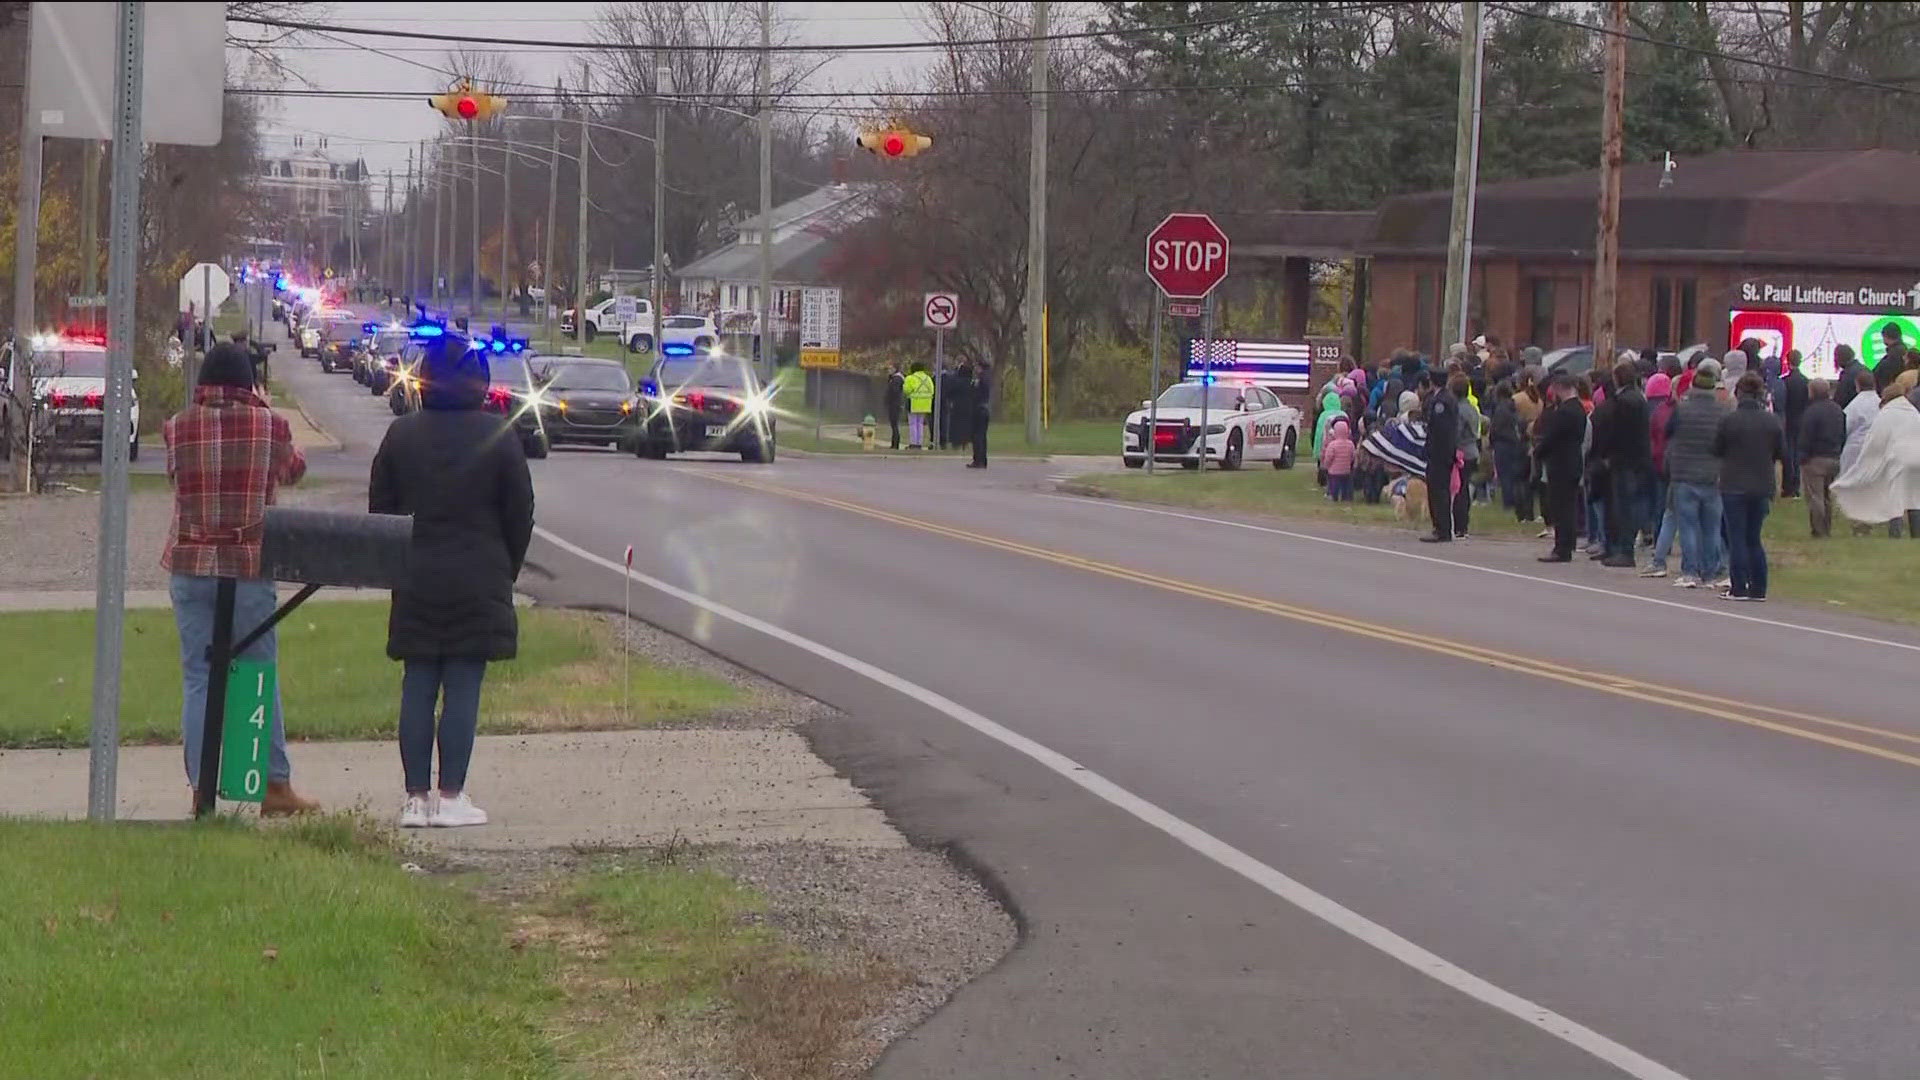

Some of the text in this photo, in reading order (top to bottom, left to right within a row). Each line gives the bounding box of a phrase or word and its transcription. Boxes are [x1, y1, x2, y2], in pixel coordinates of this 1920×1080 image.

[1152, 239, 1222, 272] STOP
[1742, 282, 1906, 306] St. Paul Lutheran Church
[1314, 345, 1339, 358] 1333
[1254, 423, 1281, 437] POLICE
[244, 672, 265, 795] 1410
